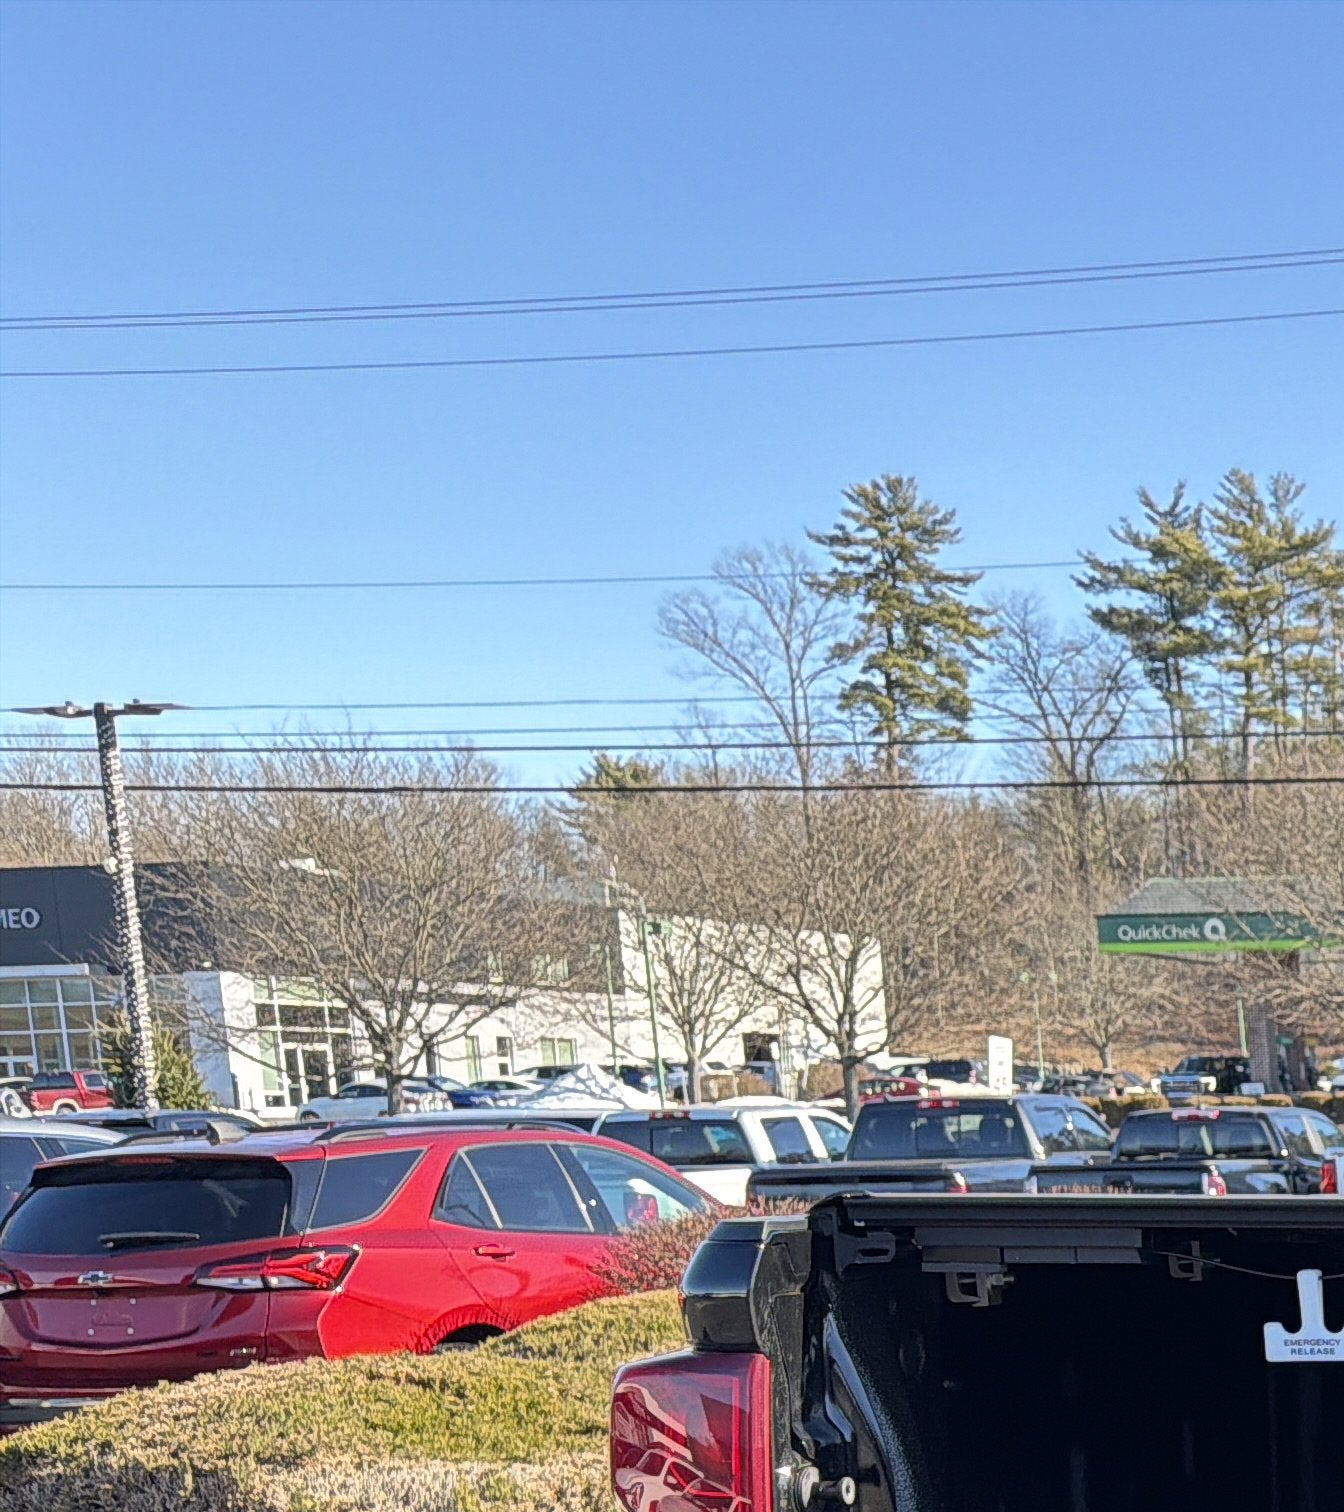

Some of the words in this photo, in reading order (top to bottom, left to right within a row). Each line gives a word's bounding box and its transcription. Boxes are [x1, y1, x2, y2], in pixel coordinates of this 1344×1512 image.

[1117, 923, 1201, 943] QuickChek
[1283, 1338, 1342, 1347] EMERGENCY
[1290, 1347, 1337, 1356] RELEASE
